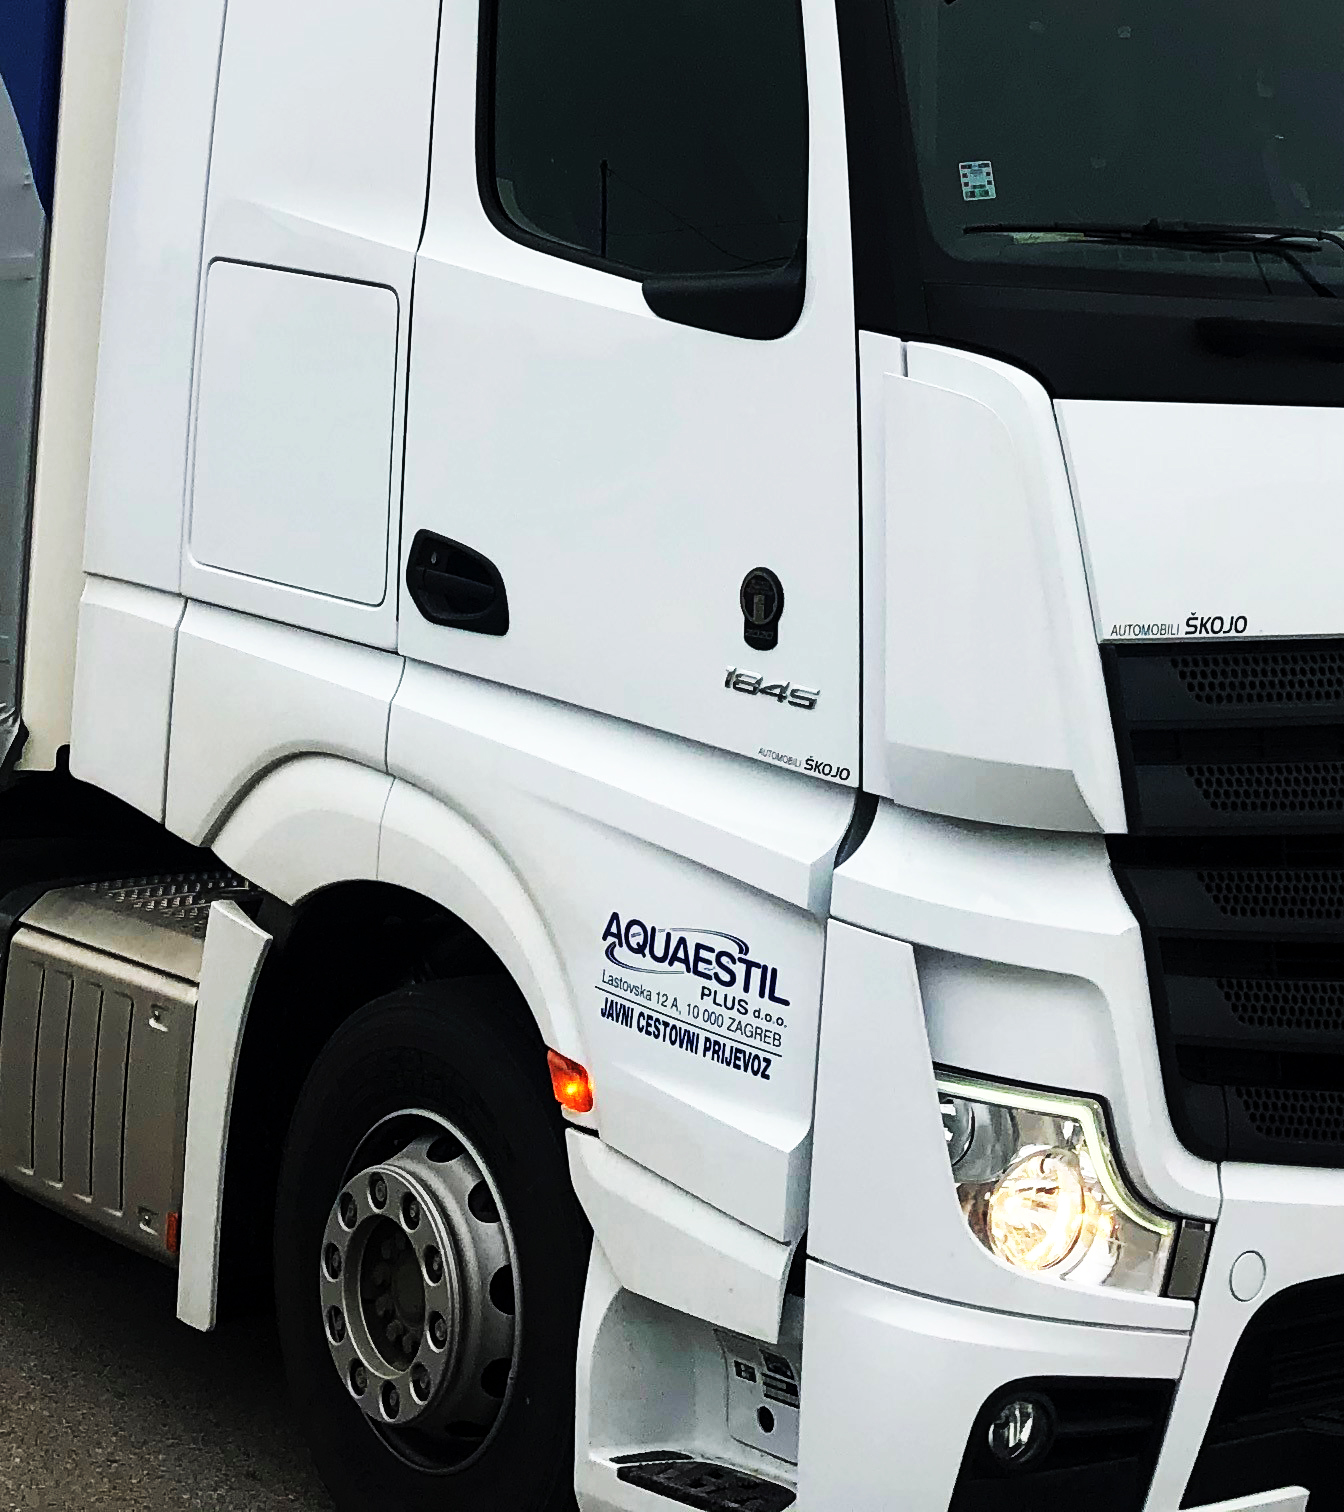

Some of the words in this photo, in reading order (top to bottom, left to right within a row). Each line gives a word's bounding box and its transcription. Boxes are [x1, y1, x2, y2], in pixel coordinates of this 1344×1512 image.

[1110, 623, 1180, 637] AUTOMOBILI
[1184, 611, 1248, 635] ŠKOJO
[724, 664, 821, 710] 1845
[758, 747, 802, 768] AUTOMOBILI
[803, 755, 851, 781] ŠKOJO
[602, 911, 791, 1006] AQUAESTIL
[602, 969, 652, 1001] Lastovska
[656, 991, 668, 1008] 12
[686, 1003, 700, 1019] 10
[702, 1008, 724, 1028] 000
[727, 1017, 782, 1048] ZAGREB
[700, 986, 748, 1016] PLUS
[752, 1008, 788, 1029] d.o.o.
[601, 997, 634, 1029] JAVNI
[637, 1011, 699, 1055] CESTOVNI
[703, 1036, 771, 1081] PRIJEVOZ
